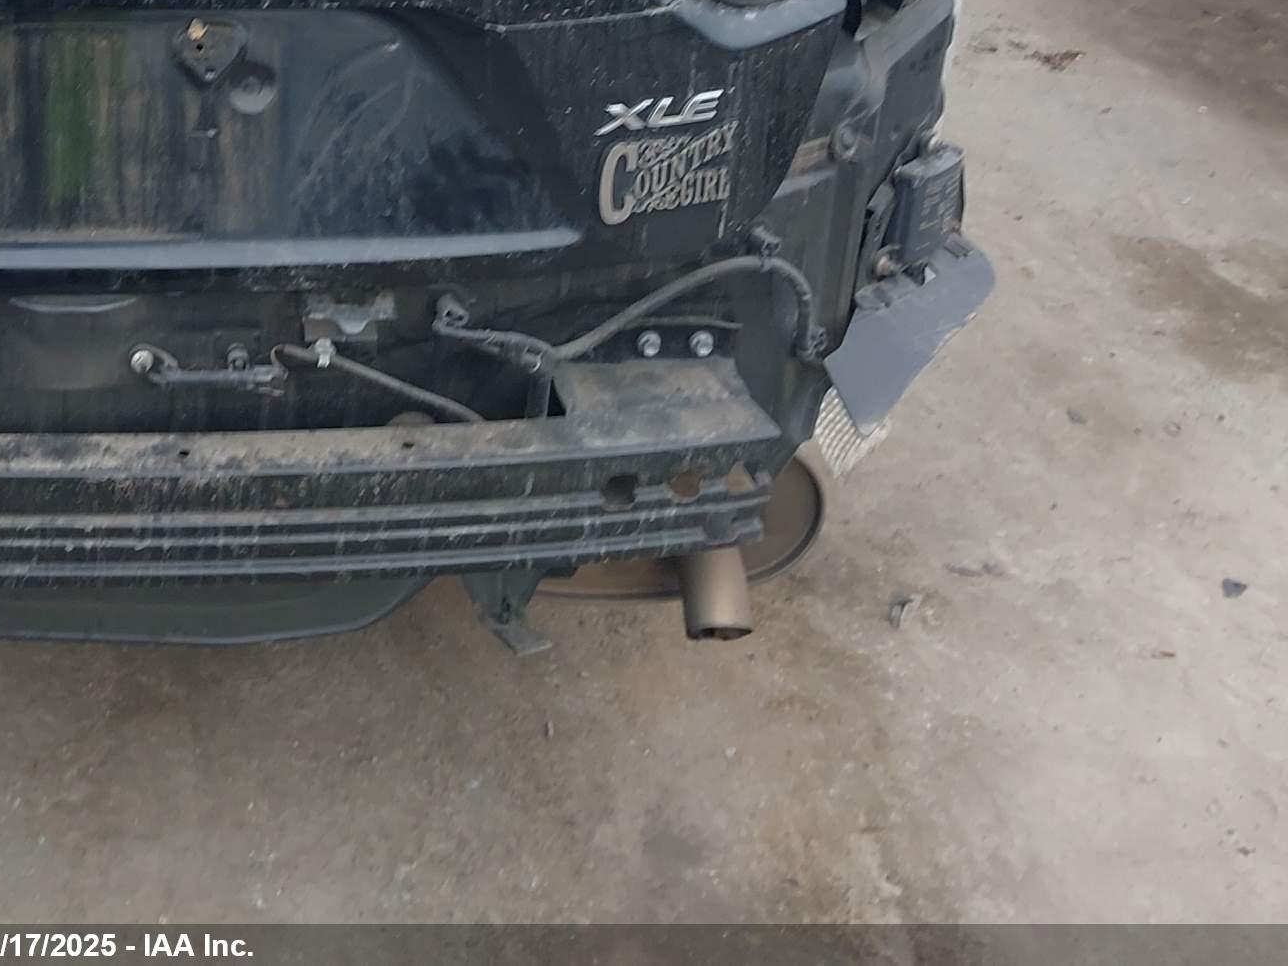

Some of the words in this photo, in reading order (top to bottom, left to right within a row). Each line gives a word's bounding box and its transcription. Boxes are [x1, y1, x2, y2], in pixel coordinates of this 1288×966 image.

[592, 89, 725, 136] XLE
[599, 120, 738, 225] COUNTRY
[678, 166, 731, 207] GIRL
